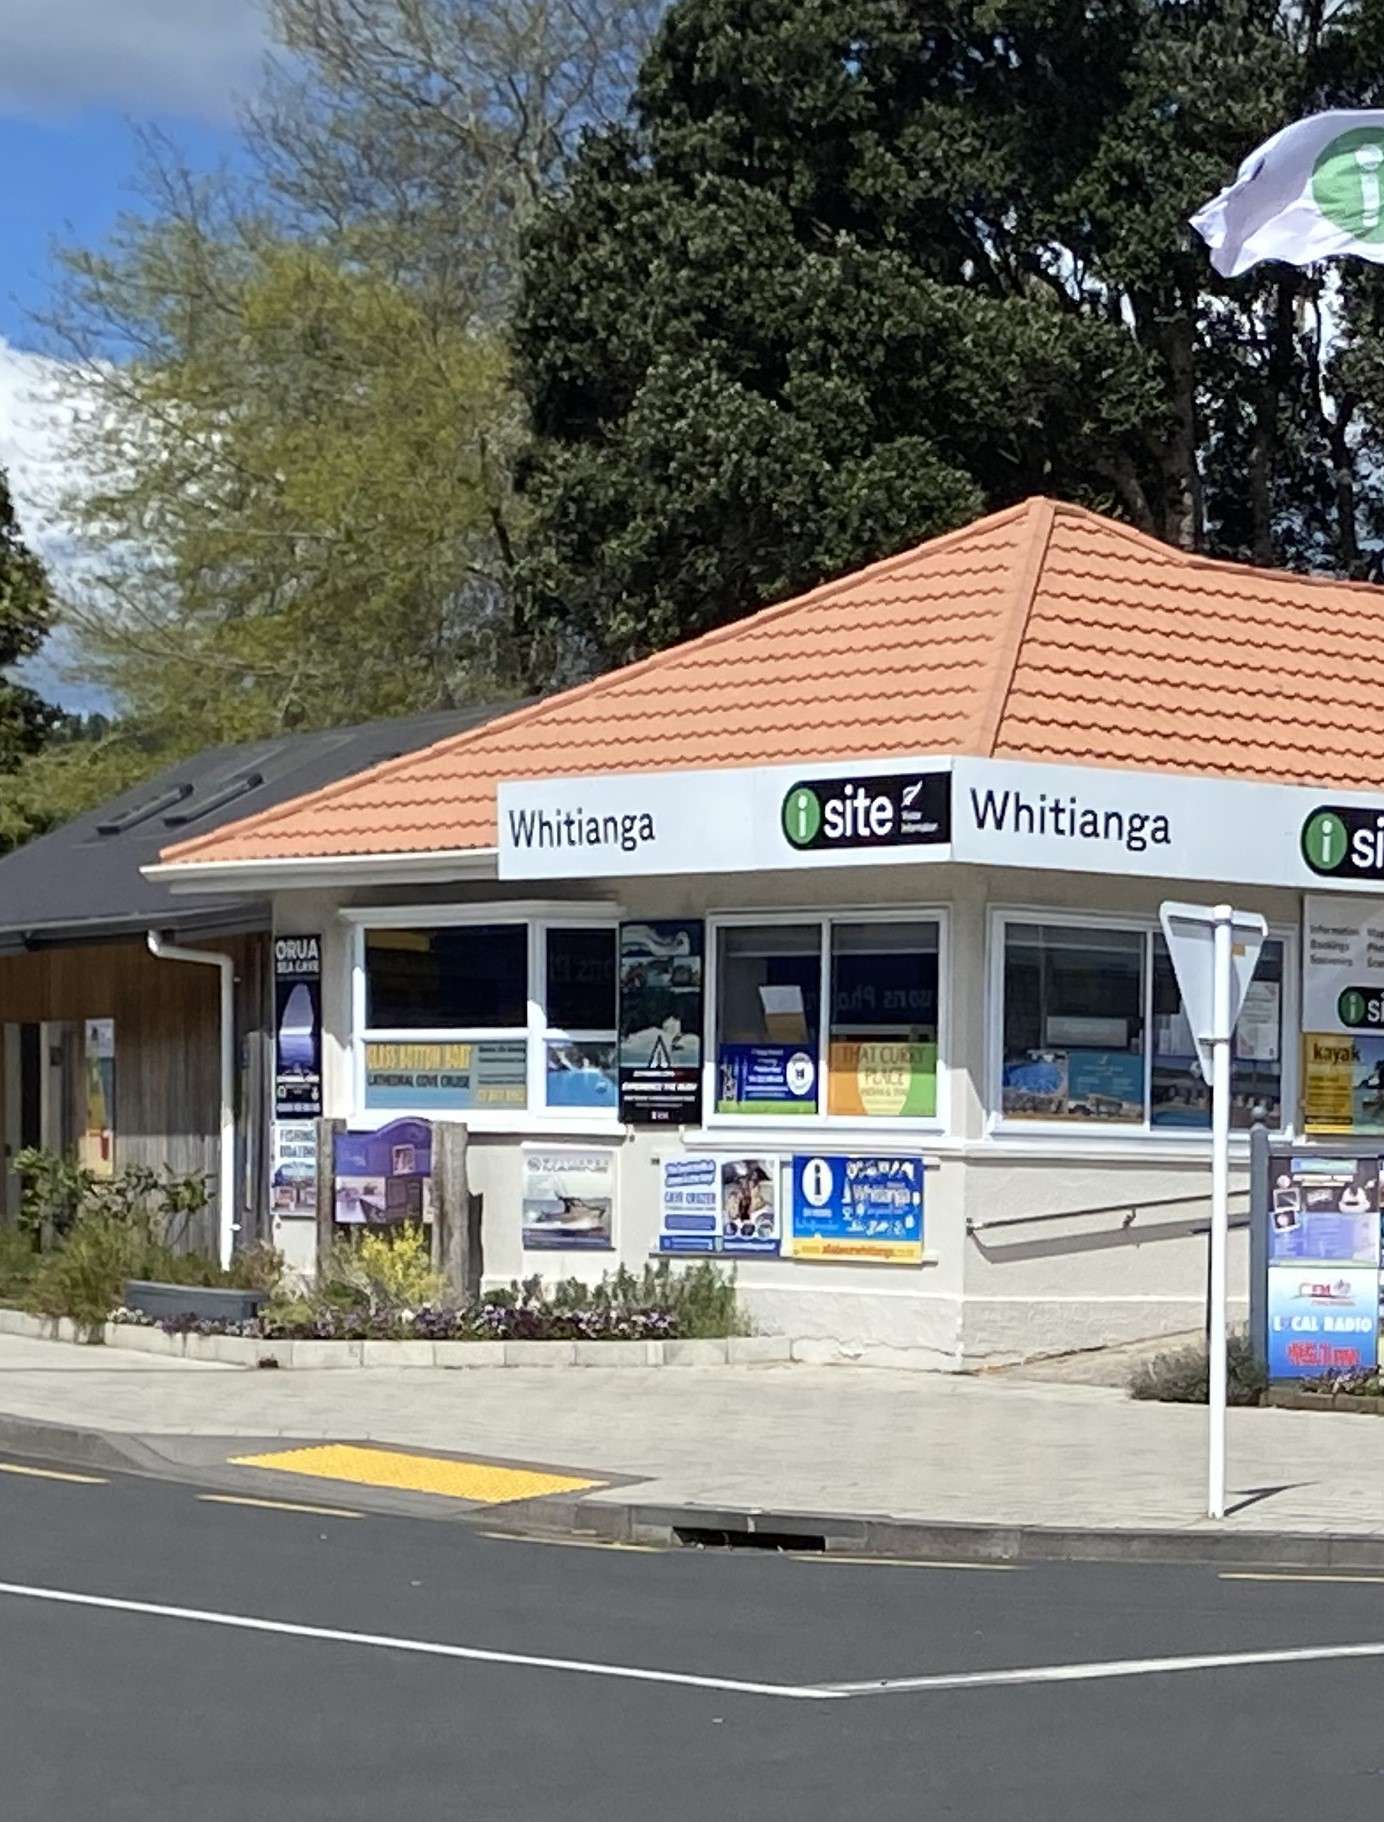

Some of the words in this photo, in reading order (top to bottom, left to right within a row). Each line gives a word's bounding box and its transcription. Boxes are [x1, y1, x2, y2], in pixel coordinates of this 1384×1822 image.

[823, 784, 894, 838] site
[969, 787, 1171, 852] Whitianga
[508, 806, 655, 851] Whitianga
[275, 940, 318, 959] ORUA
[1313, 1042, 1360, 1065] kayak
[1324, 1316, 1373, 1332] RADIO
